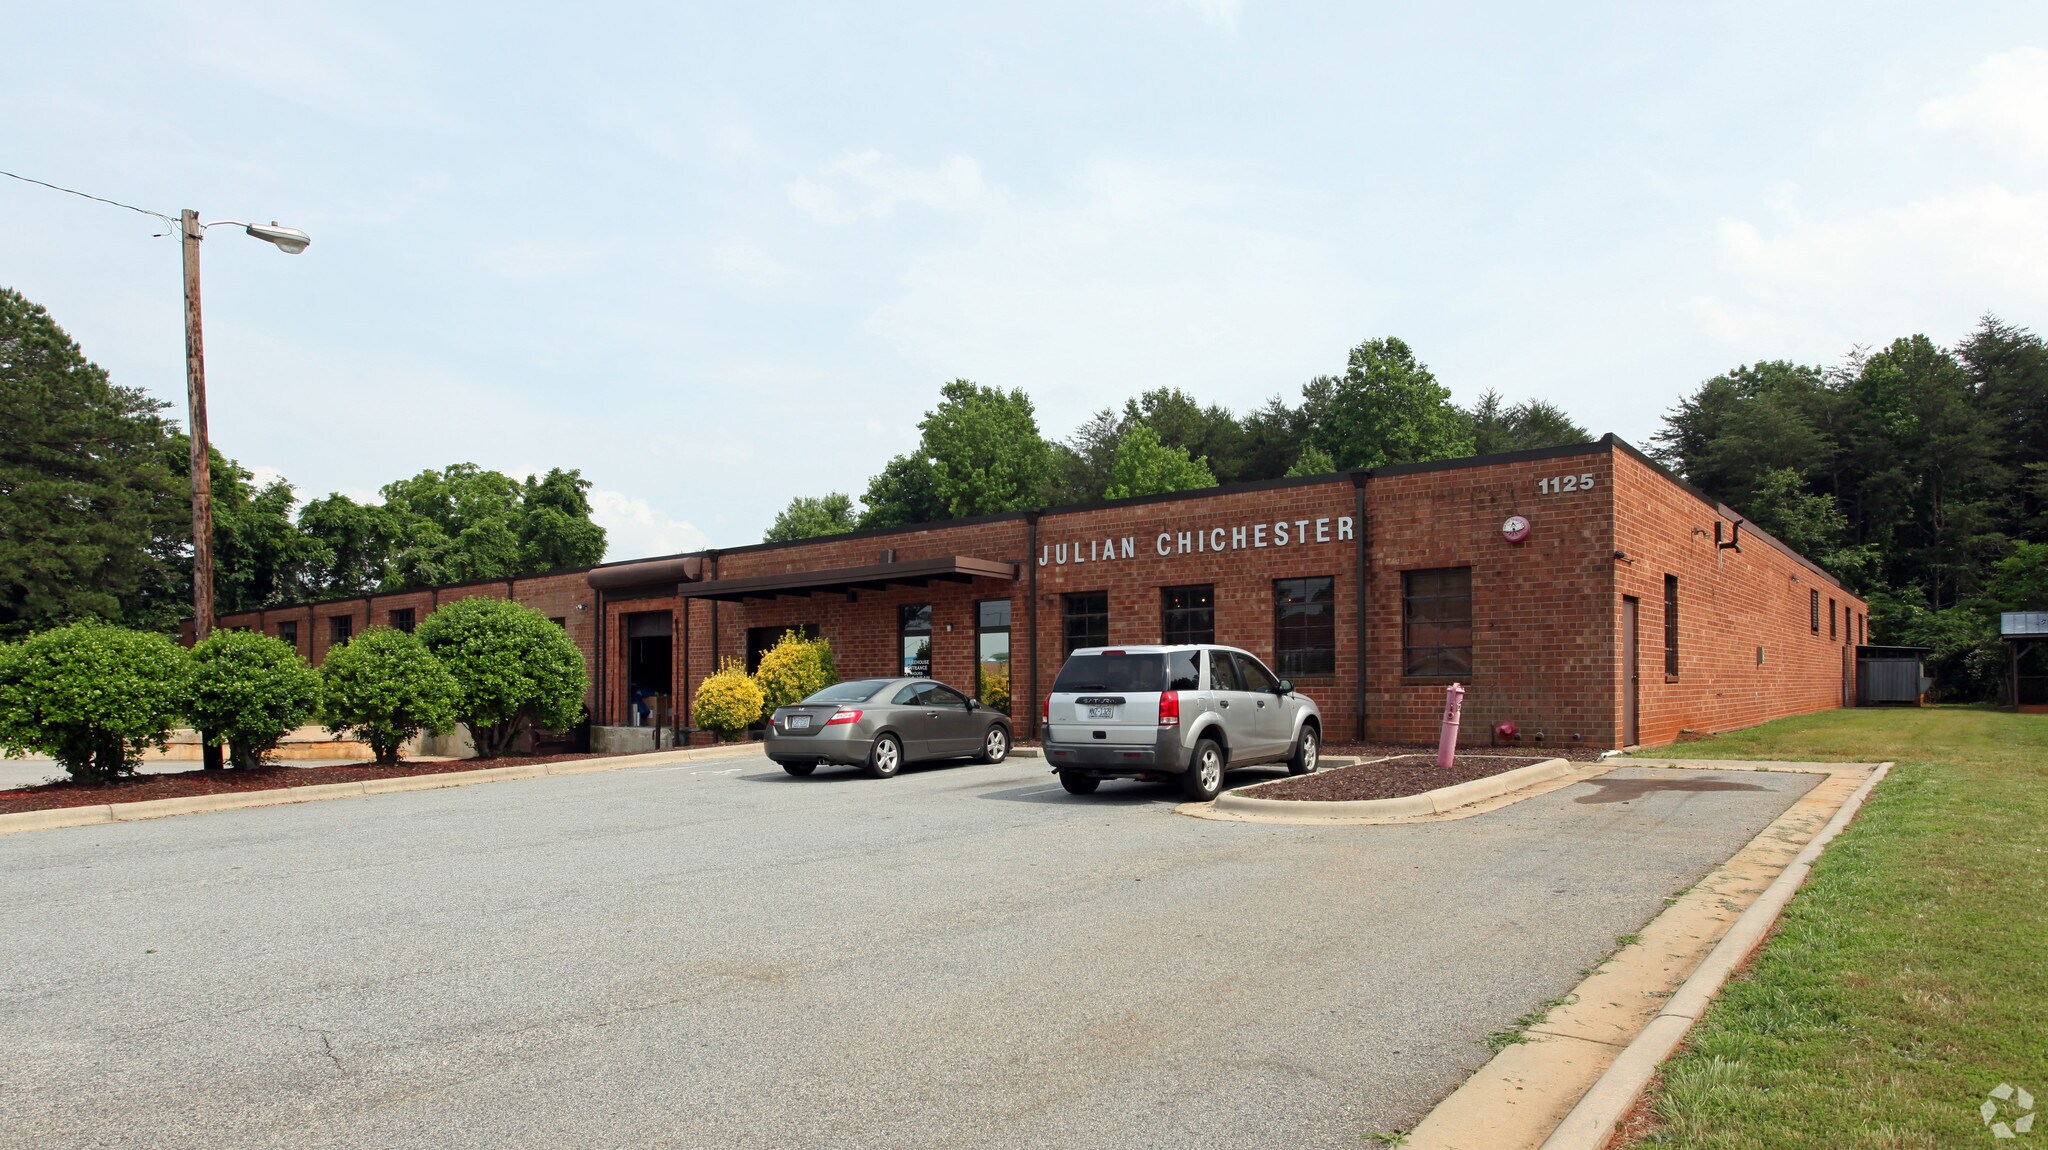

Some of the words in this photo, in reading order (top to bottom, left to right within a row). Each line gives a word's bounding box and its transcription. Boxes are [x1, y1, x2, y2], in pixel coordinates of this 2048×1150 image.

[1538, 473, 1594, 495] 1125
[1038, 536, 1135, 566] JULIAN
[1156, 516, 1354, 556] CHICHESTER
